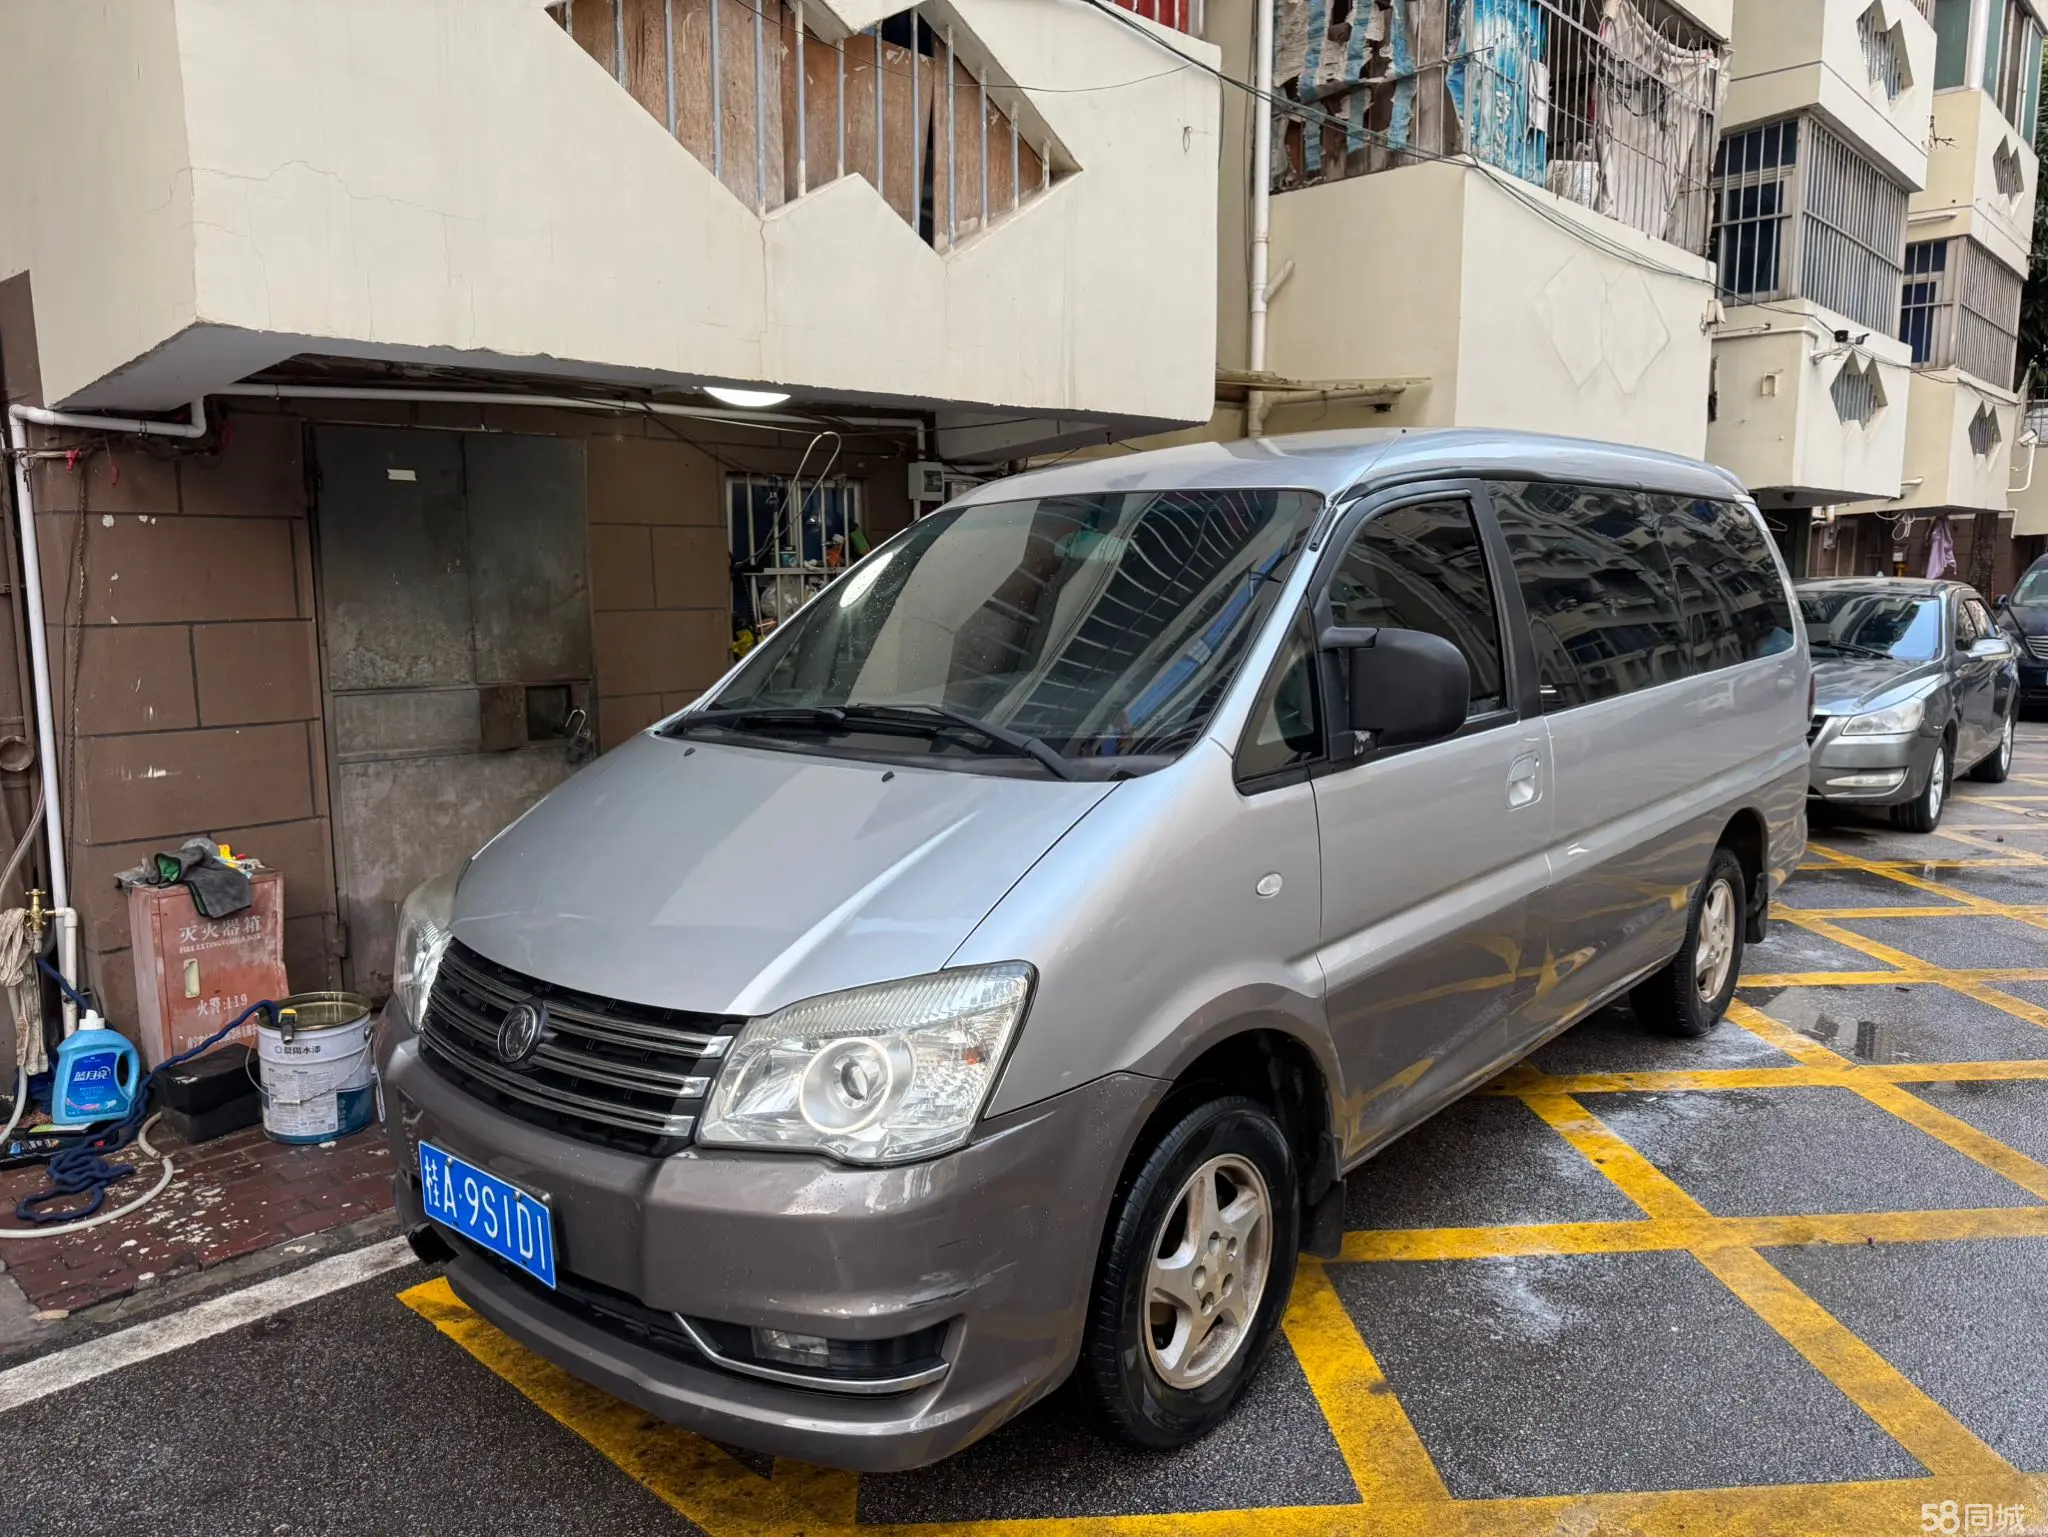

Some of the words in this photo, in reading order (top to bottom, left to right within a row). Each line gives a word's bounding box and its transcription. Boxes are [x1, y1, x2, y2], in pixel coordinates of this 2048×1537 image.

[178, 915, 261, 943] 灭火器箱
[73, 1066, 111, 1081] 蓝月亮
